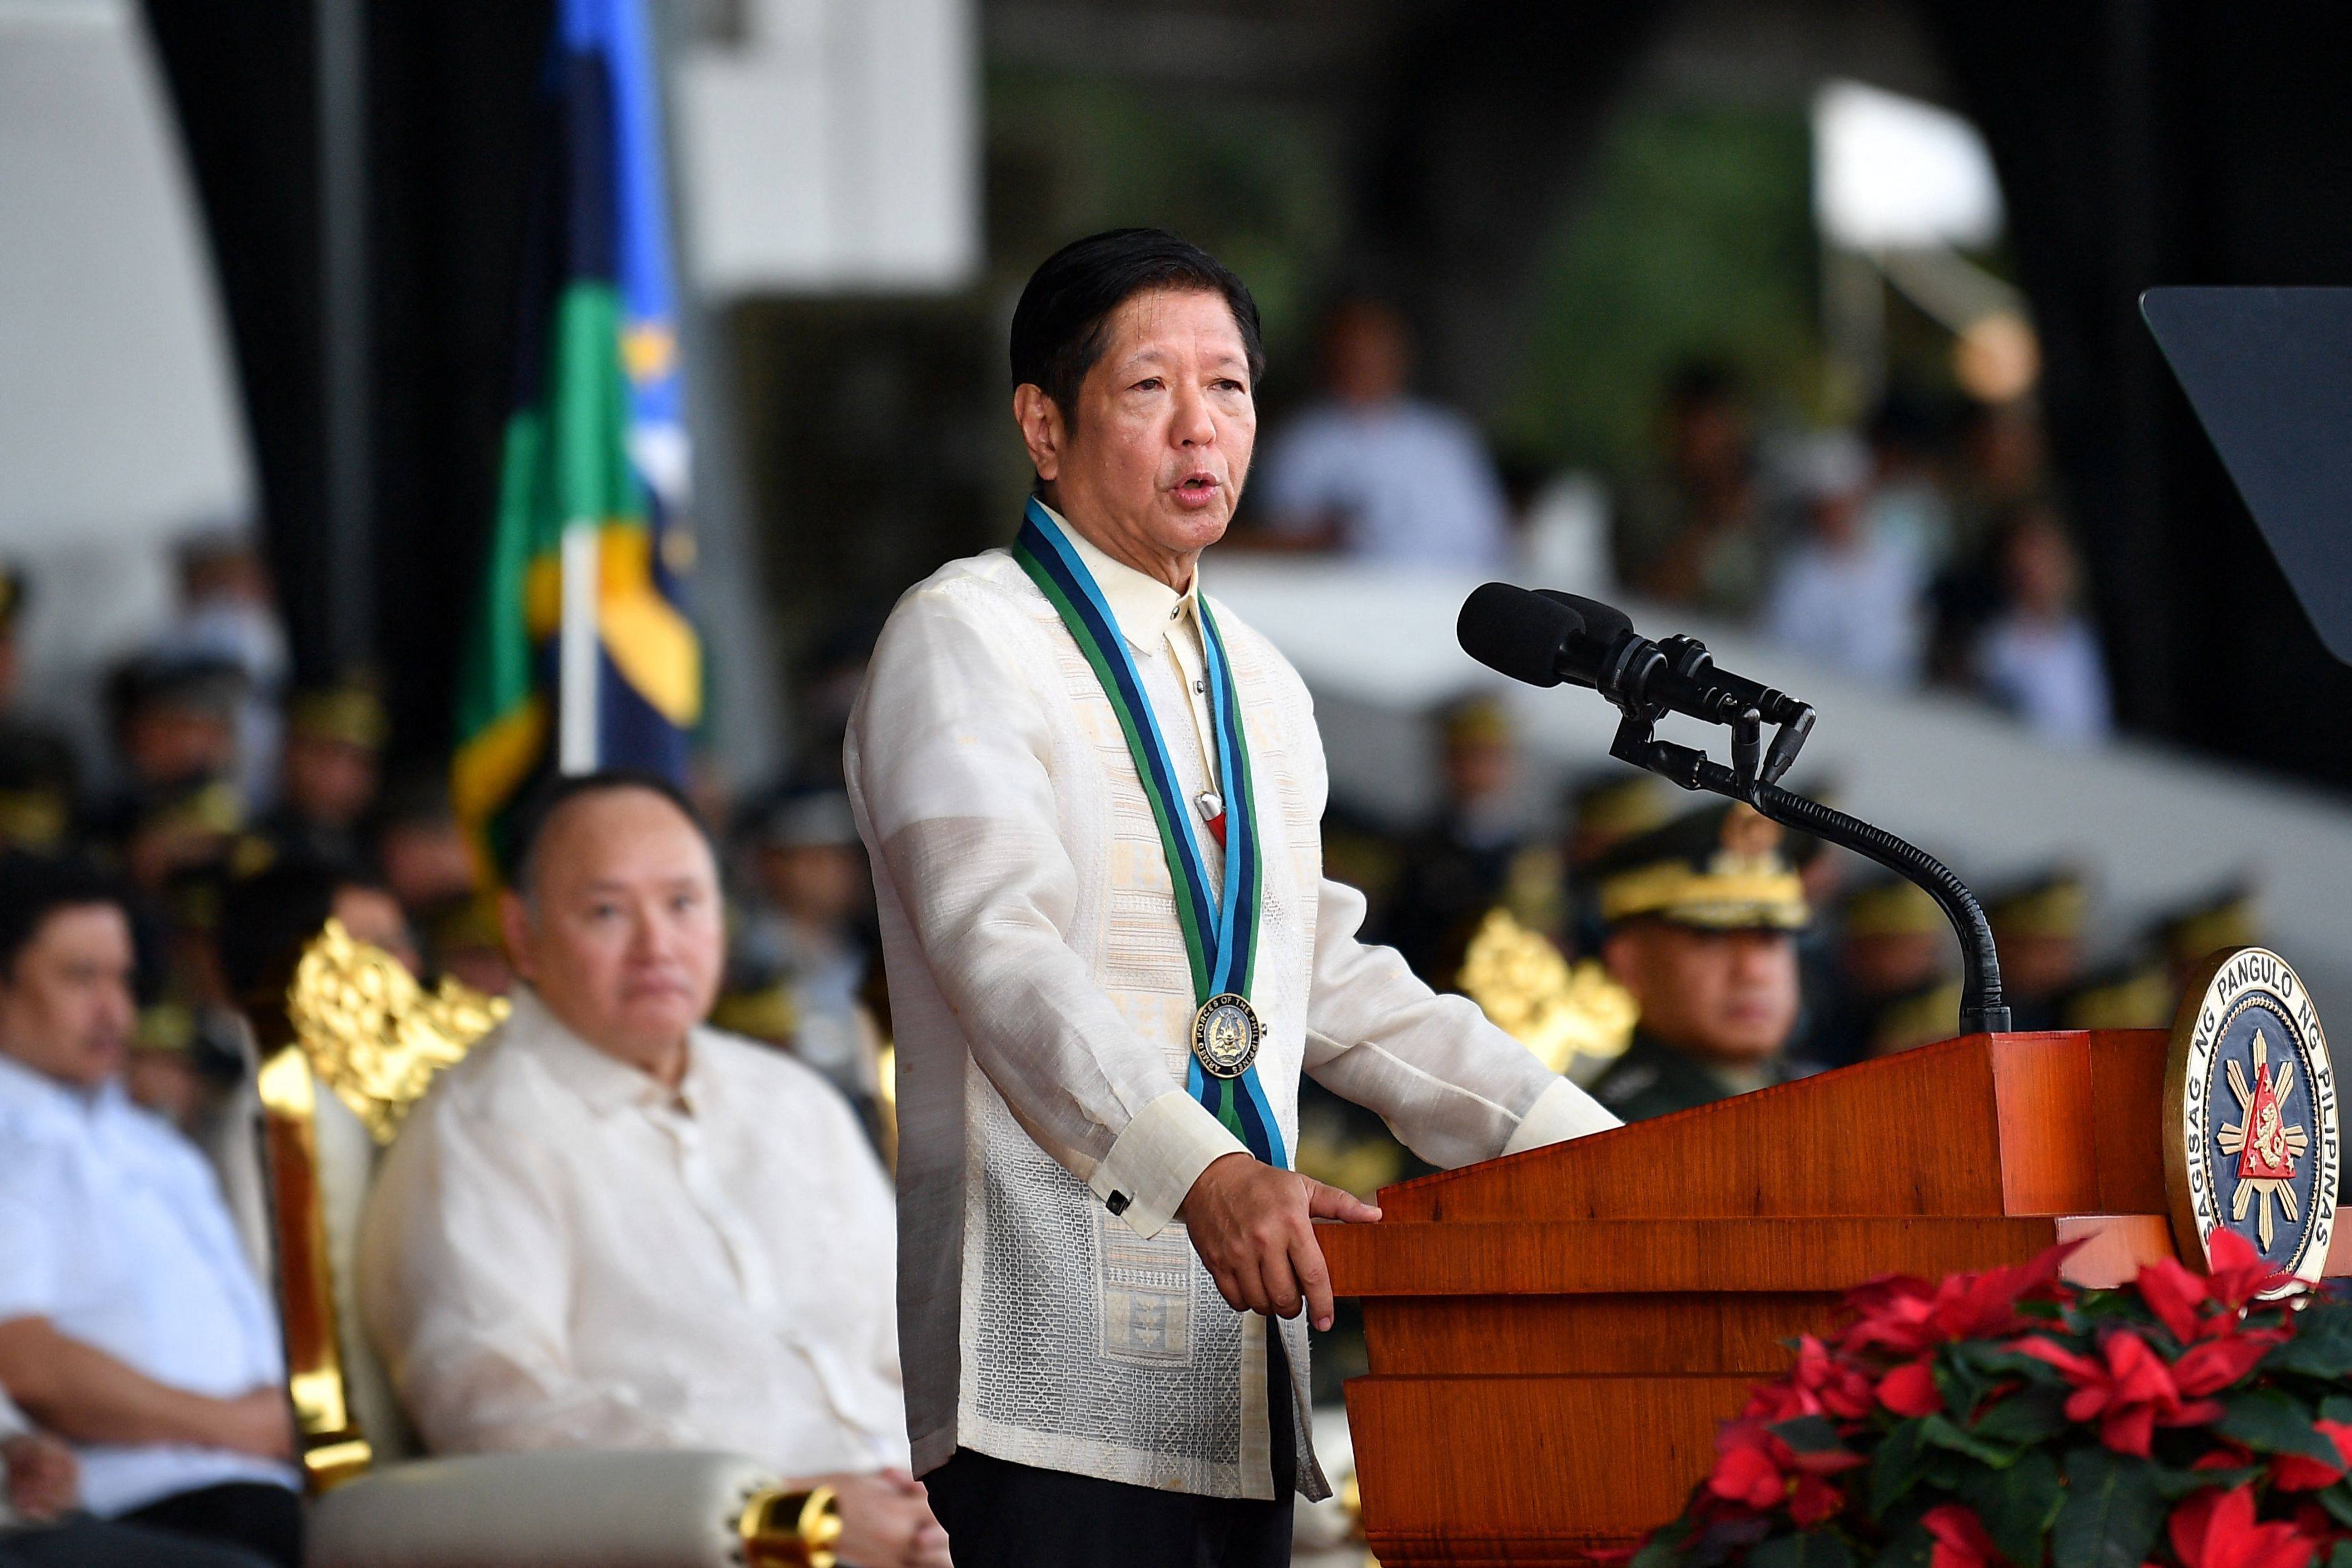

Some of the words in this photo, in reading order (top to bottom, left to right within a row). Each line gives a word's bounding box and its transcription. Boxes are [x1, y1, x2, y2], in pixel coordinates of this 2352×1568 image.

[1220, 996, 1232, 1004] OF
[1235, 998, 1249, 1014] THE
[2217, 955, 2293, 1006] PANGULO
[1197, 1000, 1219, 1038] FORCES
[2195, 1006, 2215, 1058] NG
[2298, 999, 2320, 1050] NG
[1198, 1043, 1221, 1073] ARMED
[1232, 1016, 1259, 1074] PHILIPPINES
[2189, 1076, 2214, 1246] SAGISAG
[2316, 1066, 2336, 1247] PILIPINAS
